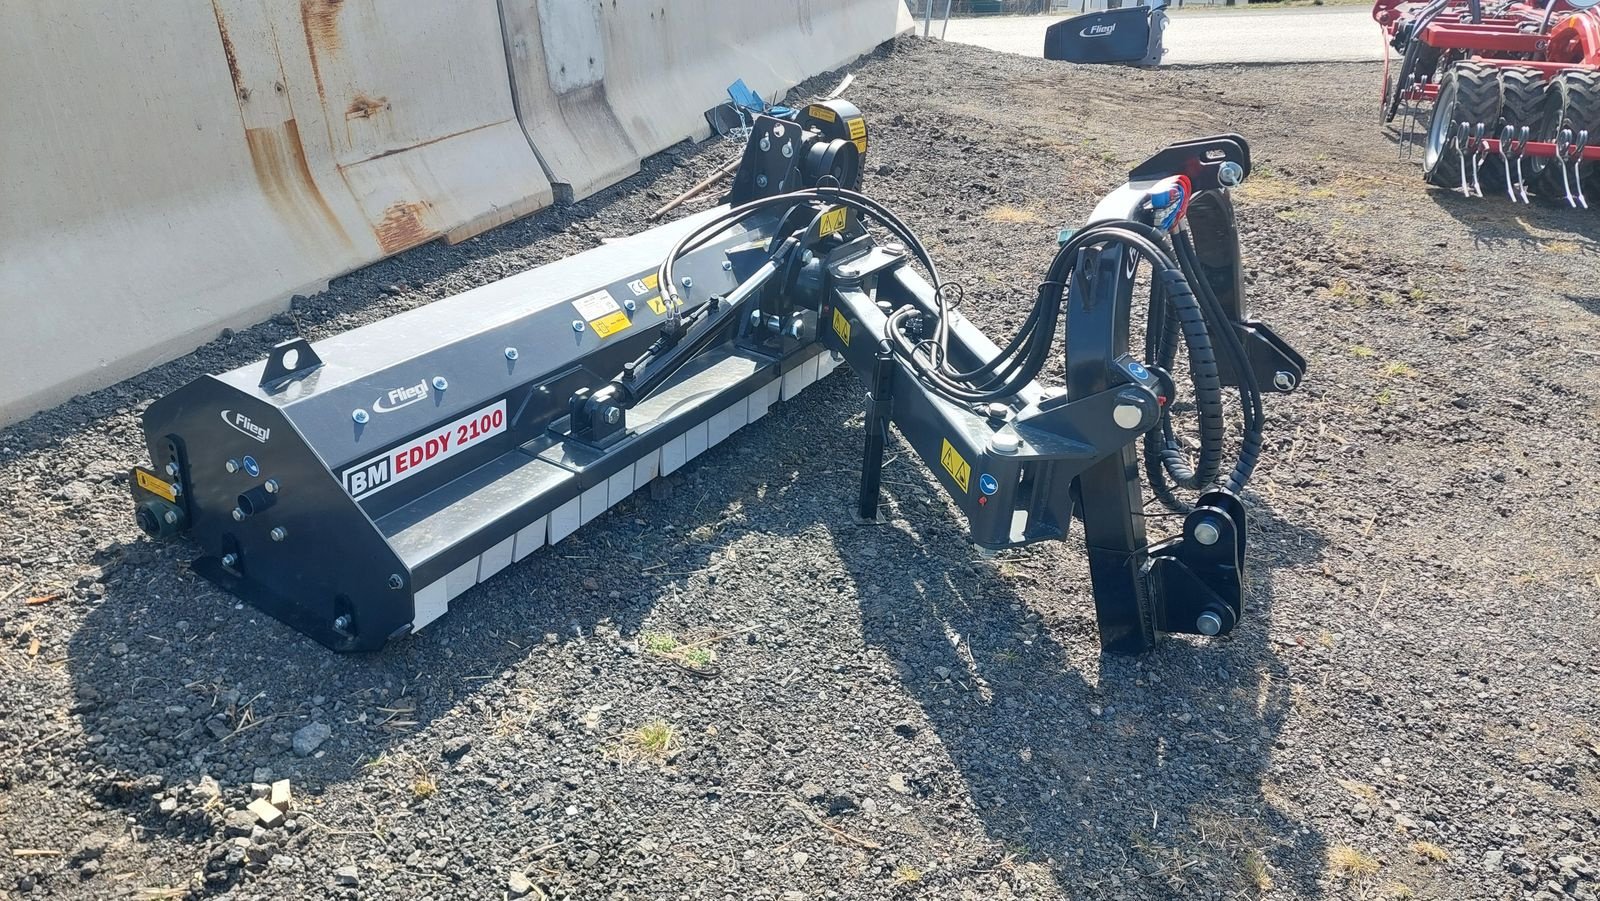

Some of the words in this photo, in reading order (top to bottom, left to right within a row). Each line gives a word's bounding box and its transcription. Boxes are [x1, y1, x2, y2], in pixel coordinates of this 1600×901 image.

[1090, 23, 1116, 35] Fliegl
[387, 378, 429, 405] Fliegl
[235, 413, 270, 441] Fliegl
[351, 459, 388, 496] BM
[395, 431, 452, 474] EDDY
[456, 409, 503, 446] 2100
